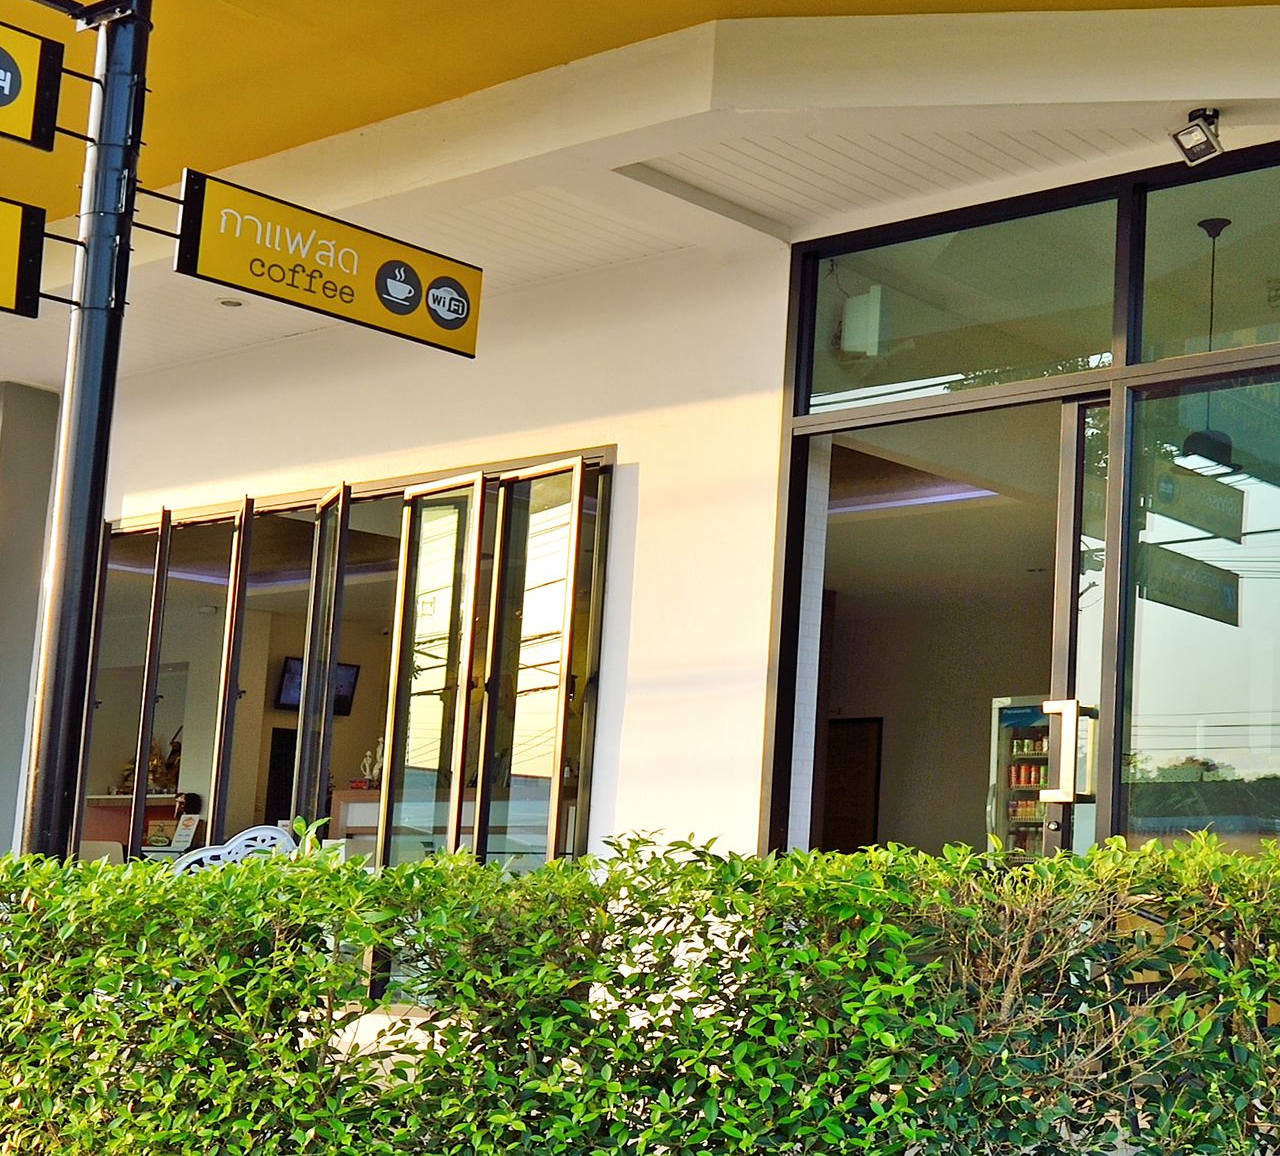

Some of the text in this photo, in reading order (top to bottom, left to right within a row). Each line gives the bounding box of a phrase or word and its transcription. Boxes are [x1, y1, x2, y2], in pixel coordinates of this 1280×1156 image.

[220, 207, 359, 276] กาแฟสด
[249, 257, 355, 304] coffee
